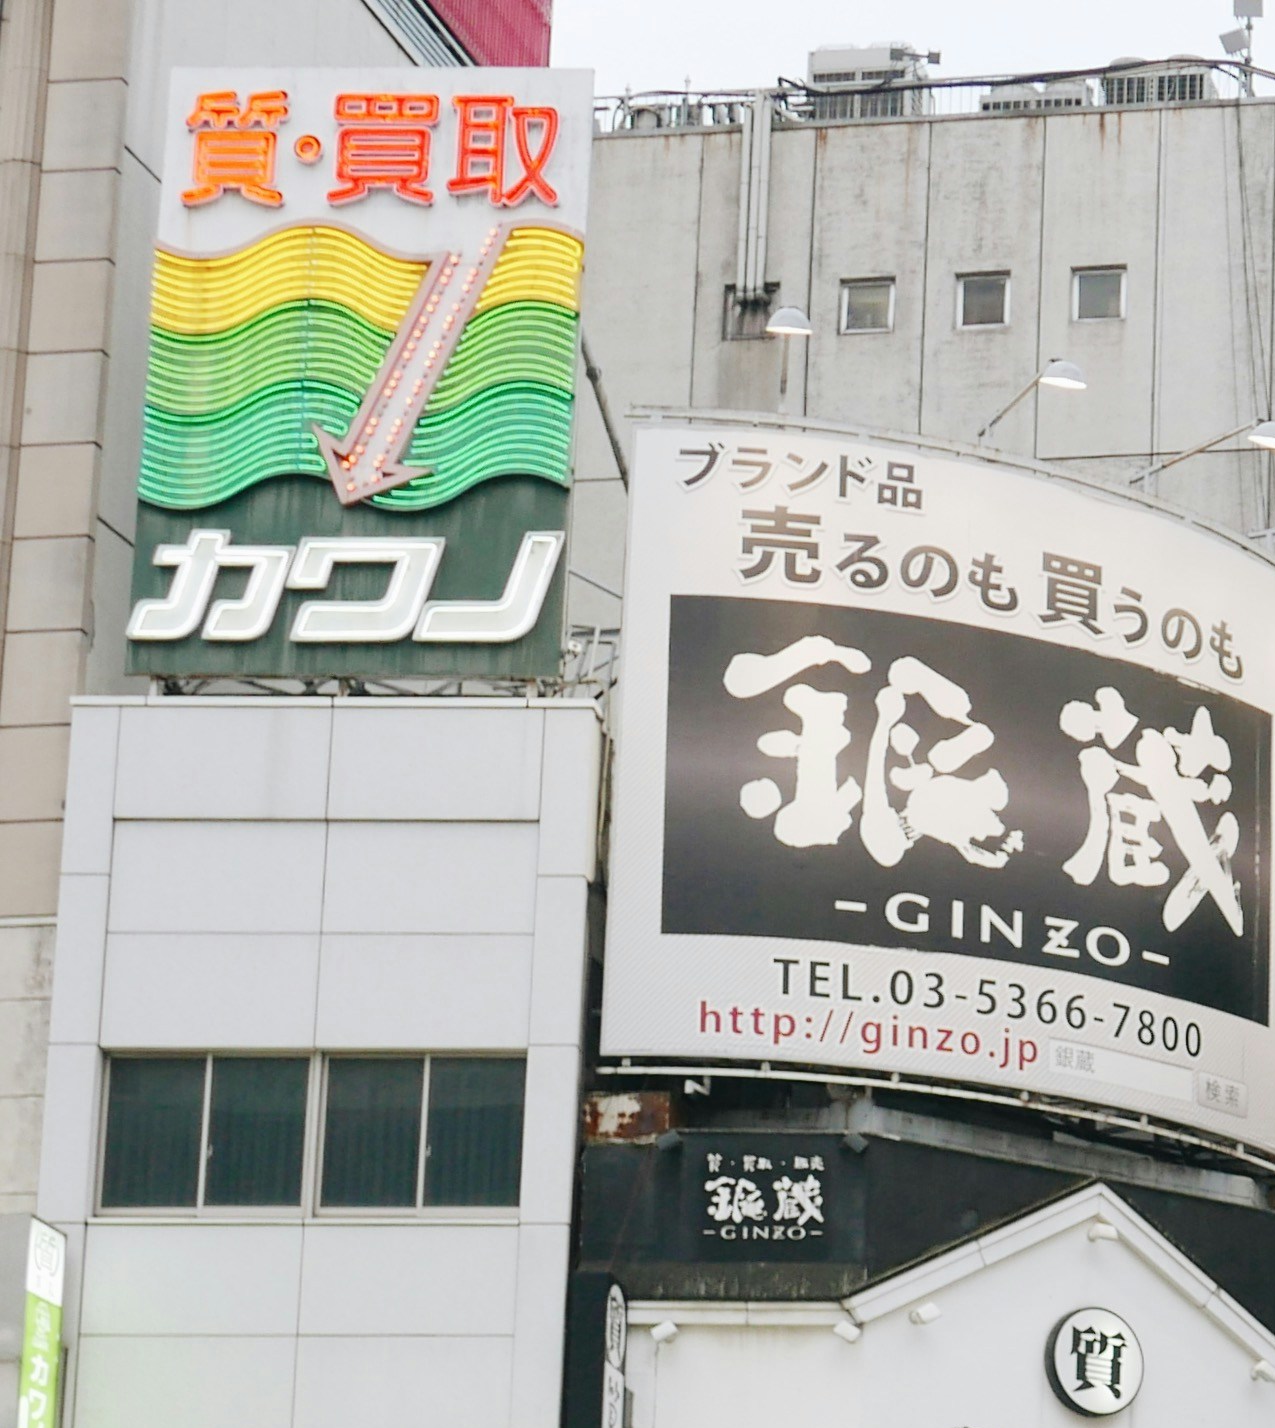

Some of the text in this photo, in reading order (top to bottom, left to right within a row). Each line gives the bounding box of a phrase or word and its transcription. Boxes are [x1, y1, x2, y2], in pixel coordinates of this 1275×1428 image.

[181, 90, 560, 207] 質・買取
[676, 445, 924, 510] ブランド品
[126, 528, 565, 641] カワノ
[722, 634, 1245, 937] 銀蔵
[699, 1000, 1040, 1070] http://ginzo.jp
[774, 957, 1203, 1058] TEL.03-5366-7800
[1055, 1045, 1095, 1074] 銀蔵
[1205, 1080, 1240, 1108] 検索
[704, 1174, 825, 1225] 銀蔵
[1071, 1326, 1127, 1399] 質
